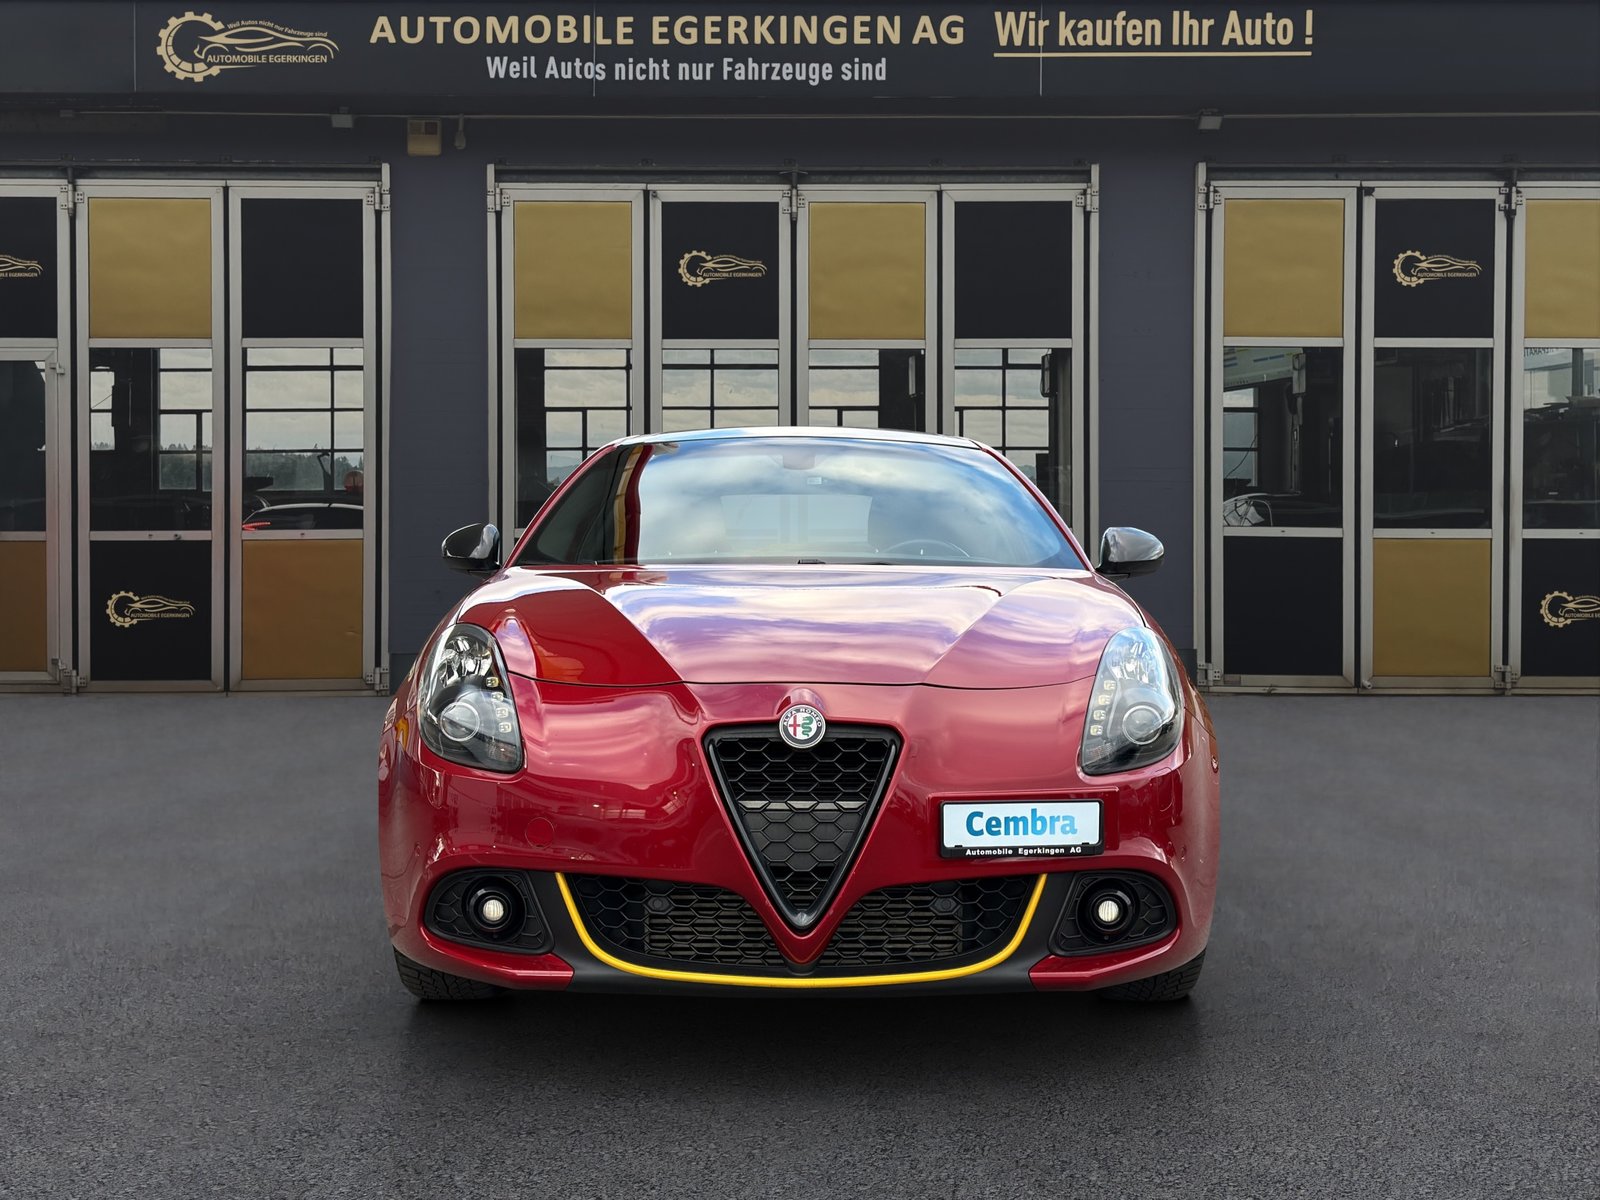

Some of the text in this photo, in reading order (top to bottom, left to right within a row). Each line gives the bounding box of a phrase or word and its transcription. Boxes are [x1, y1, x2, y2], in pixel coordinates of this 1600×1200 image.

[259, 20, 274, 28] nicht
[284, 27, 314, 37] Fahrzeuge
[369, 14, 965, 45] AUTOMOBILE EGERKINGEN AG
[994, 9, 1314, 46] Wir kaufen Ihr Auto !
[206, 54, 328, 63] AUTOMOBILE EGERKINGEN
[486, 56, 887, 86] Weil Autos nicht nur Fahrzeuge sind
[966, 808, 1078, 837] Cembra
[965, 846, 1082, 856] Automobile Egerkingen AG
